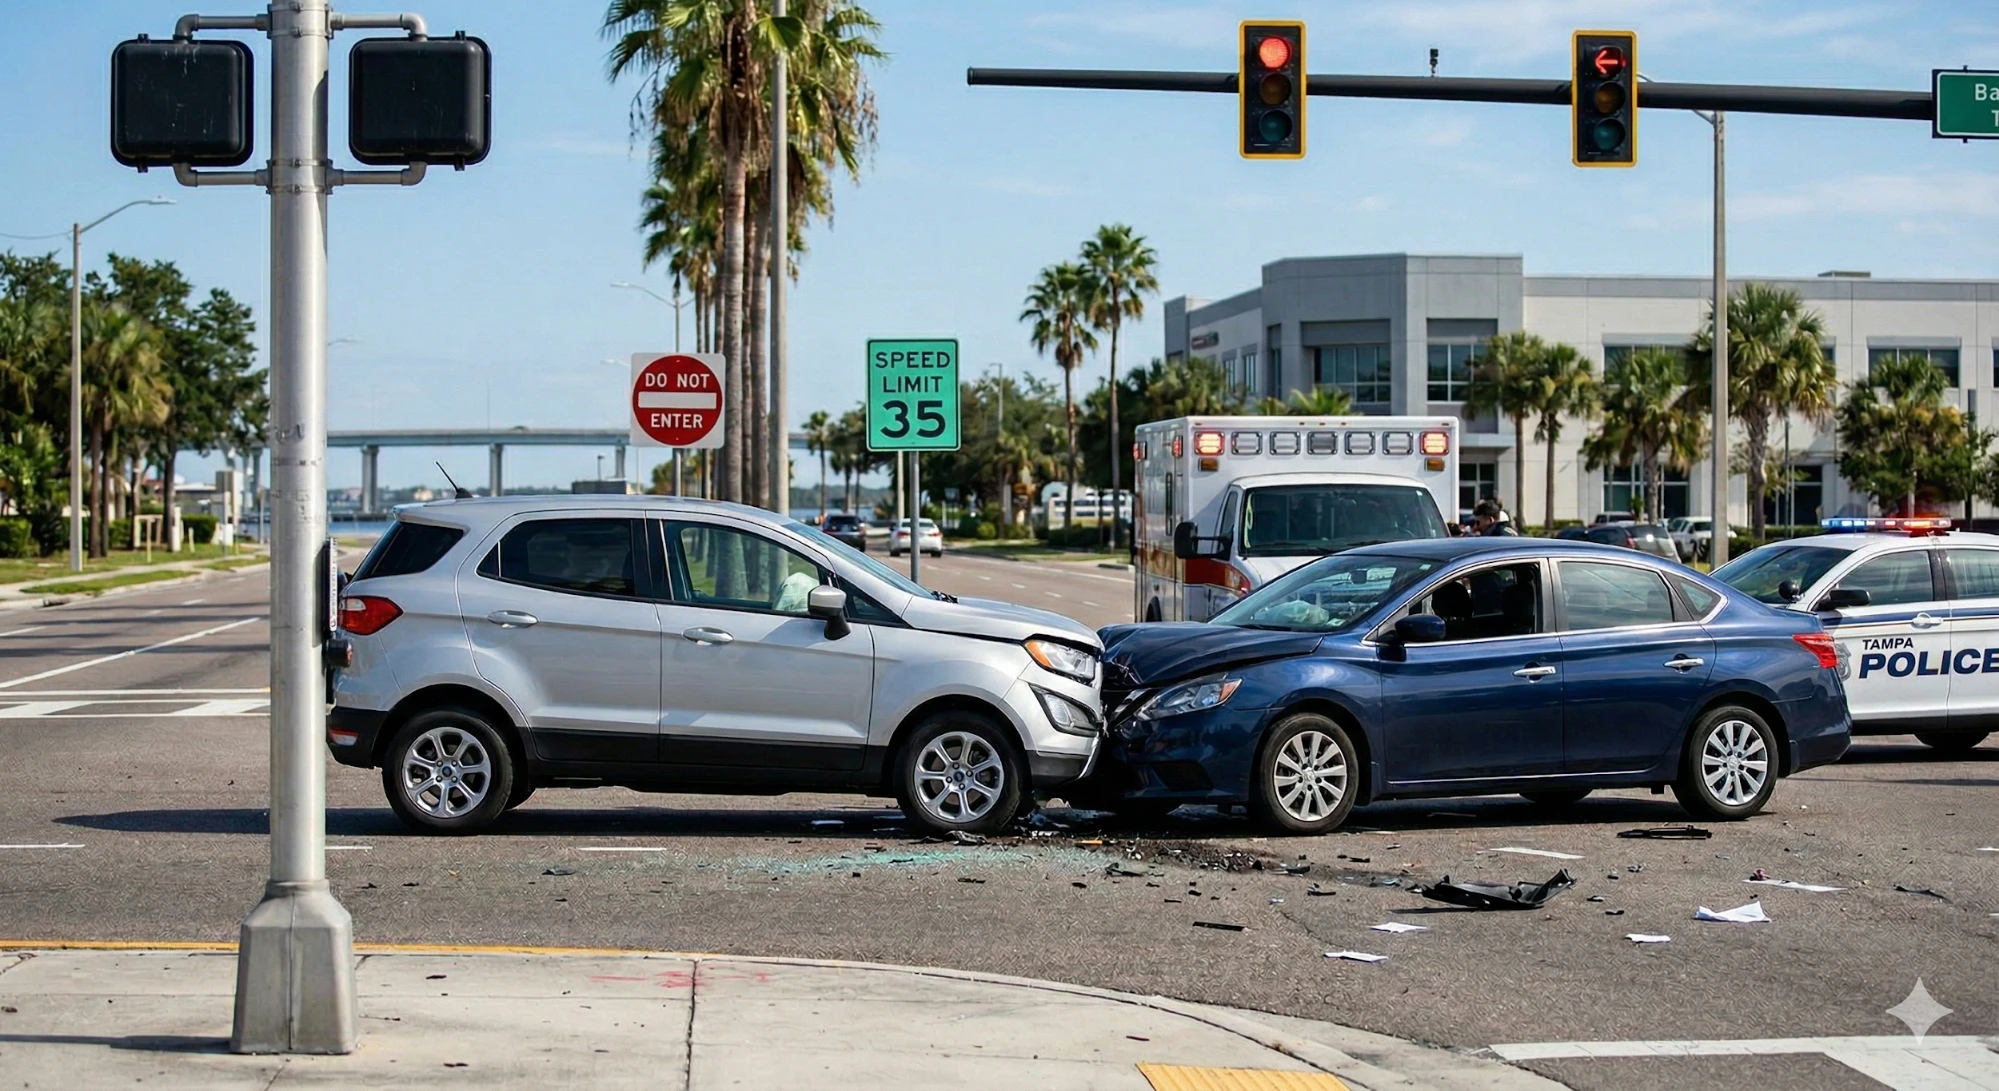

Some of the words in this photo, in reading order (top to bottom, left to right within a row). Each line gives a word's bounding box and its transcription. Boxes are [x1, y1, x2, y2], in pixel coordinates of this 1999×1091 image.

[875, 352, 950, 368] SPEED
[645, 373, 667, 388] DO
[677, 373, 710, 388] NOT
[883, 376, 943, 393] LIMIT
[650, 413, 703, 429] ENTER
[880, 400, 946, 439] 35
[1862, 637, 1914, 650] TAMPA
[1858, 648, 1999, 679] POLICE
